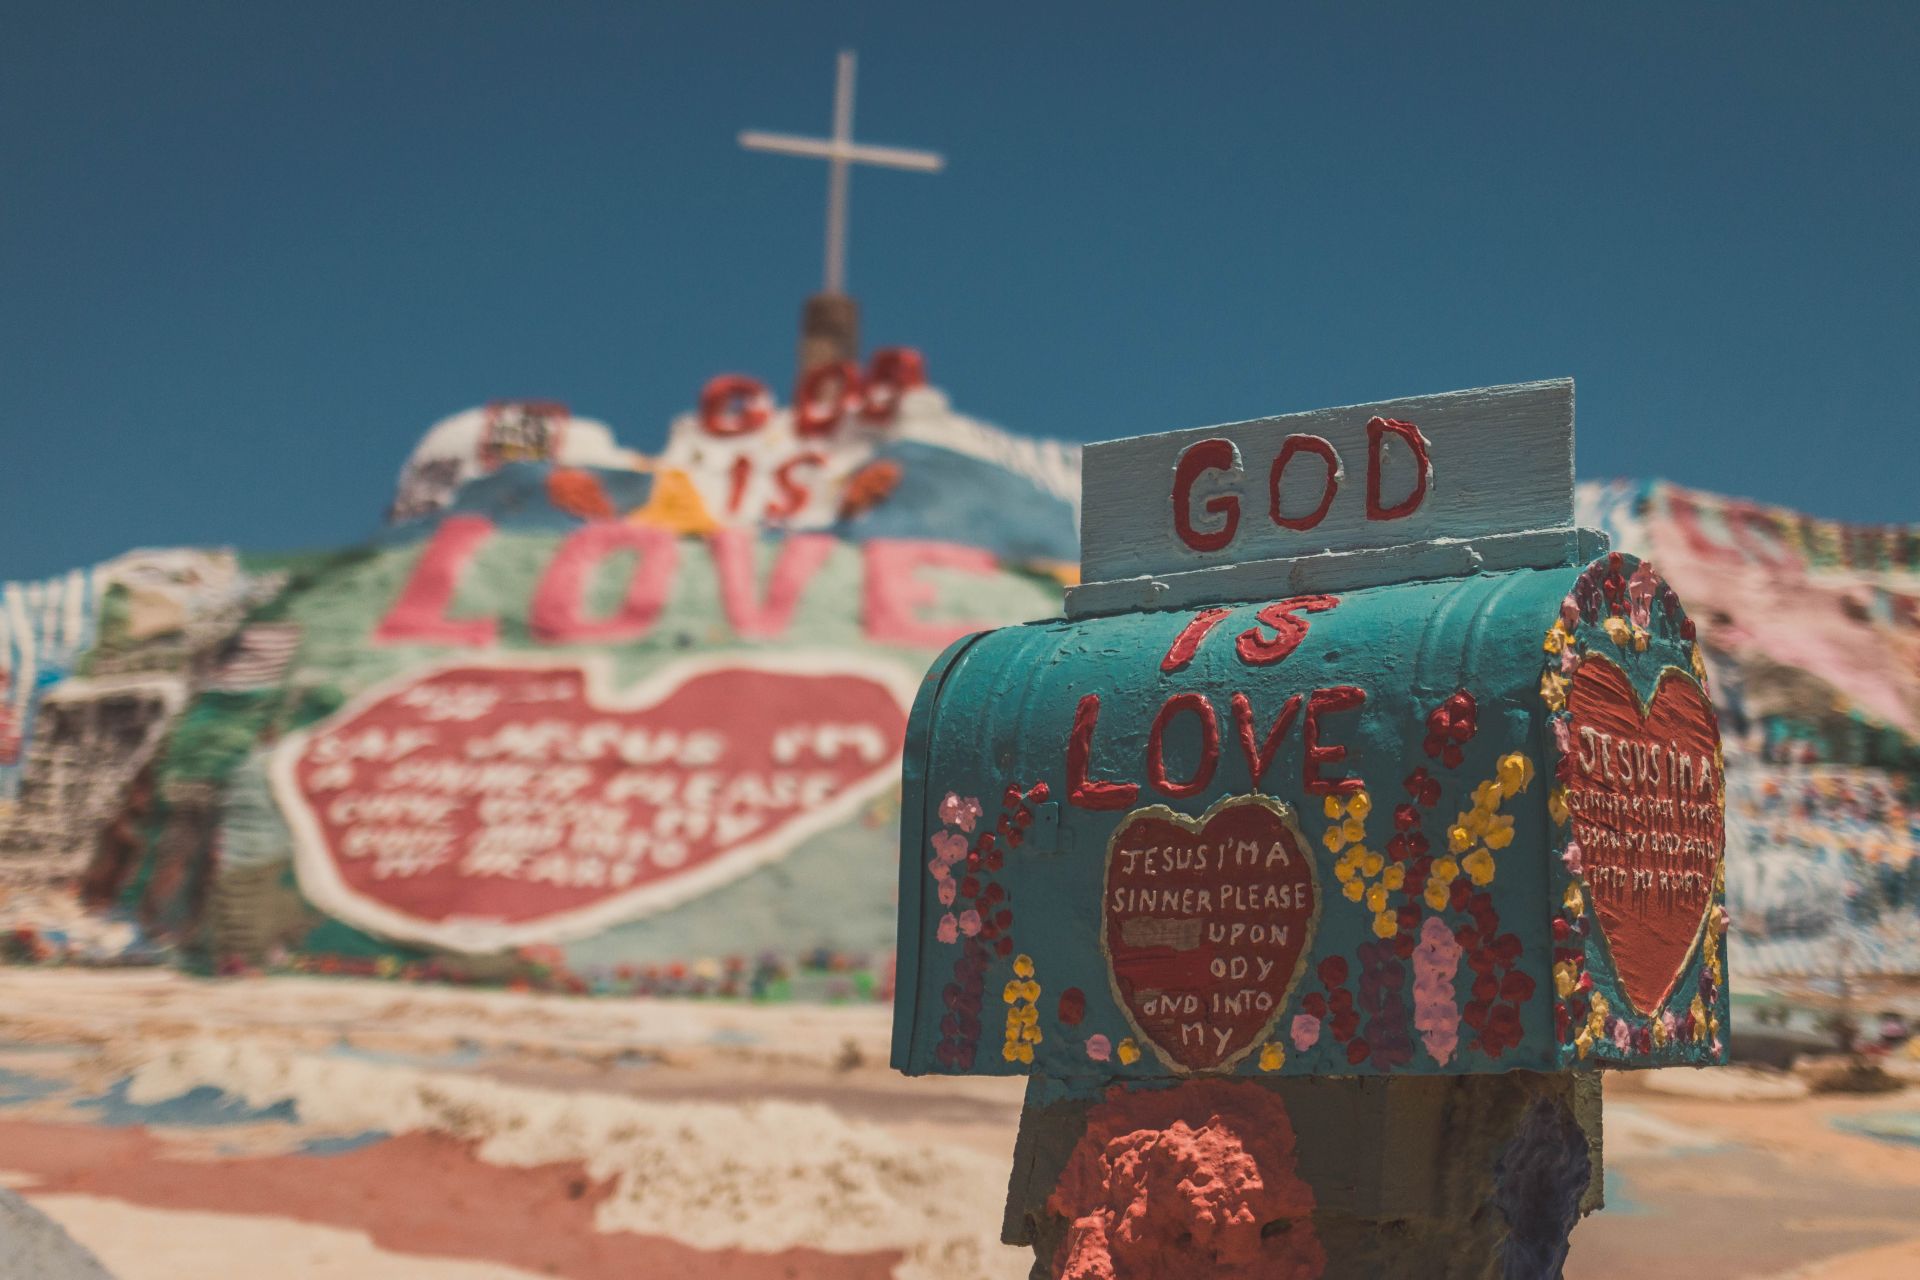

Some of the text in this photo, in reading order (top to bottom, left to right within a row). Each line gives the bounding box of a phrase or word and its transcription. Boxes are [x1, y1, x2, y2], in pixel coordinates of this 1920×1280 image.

[727, 453, 828, 519] IS
[1172, 416, 1434, 552] GOD
[374, 515, 1003, 648] LOVE
[1160, 594, 1340, 673] IS
[1066, 685, 1367, 811] LOVE
[1578, 726, 1661, 786] JESUS
[1699, 756, 1714, 793] A
[1120, 837, 1290, 875] JESUS I'M A
[1112, 882, 1306, 914] SINNER PLEASE
[1209, 922, 1289, 946] UPON
[1213, 989, 1273, 1016] INTO
[1181, 1022, 1233, 1057] MY
